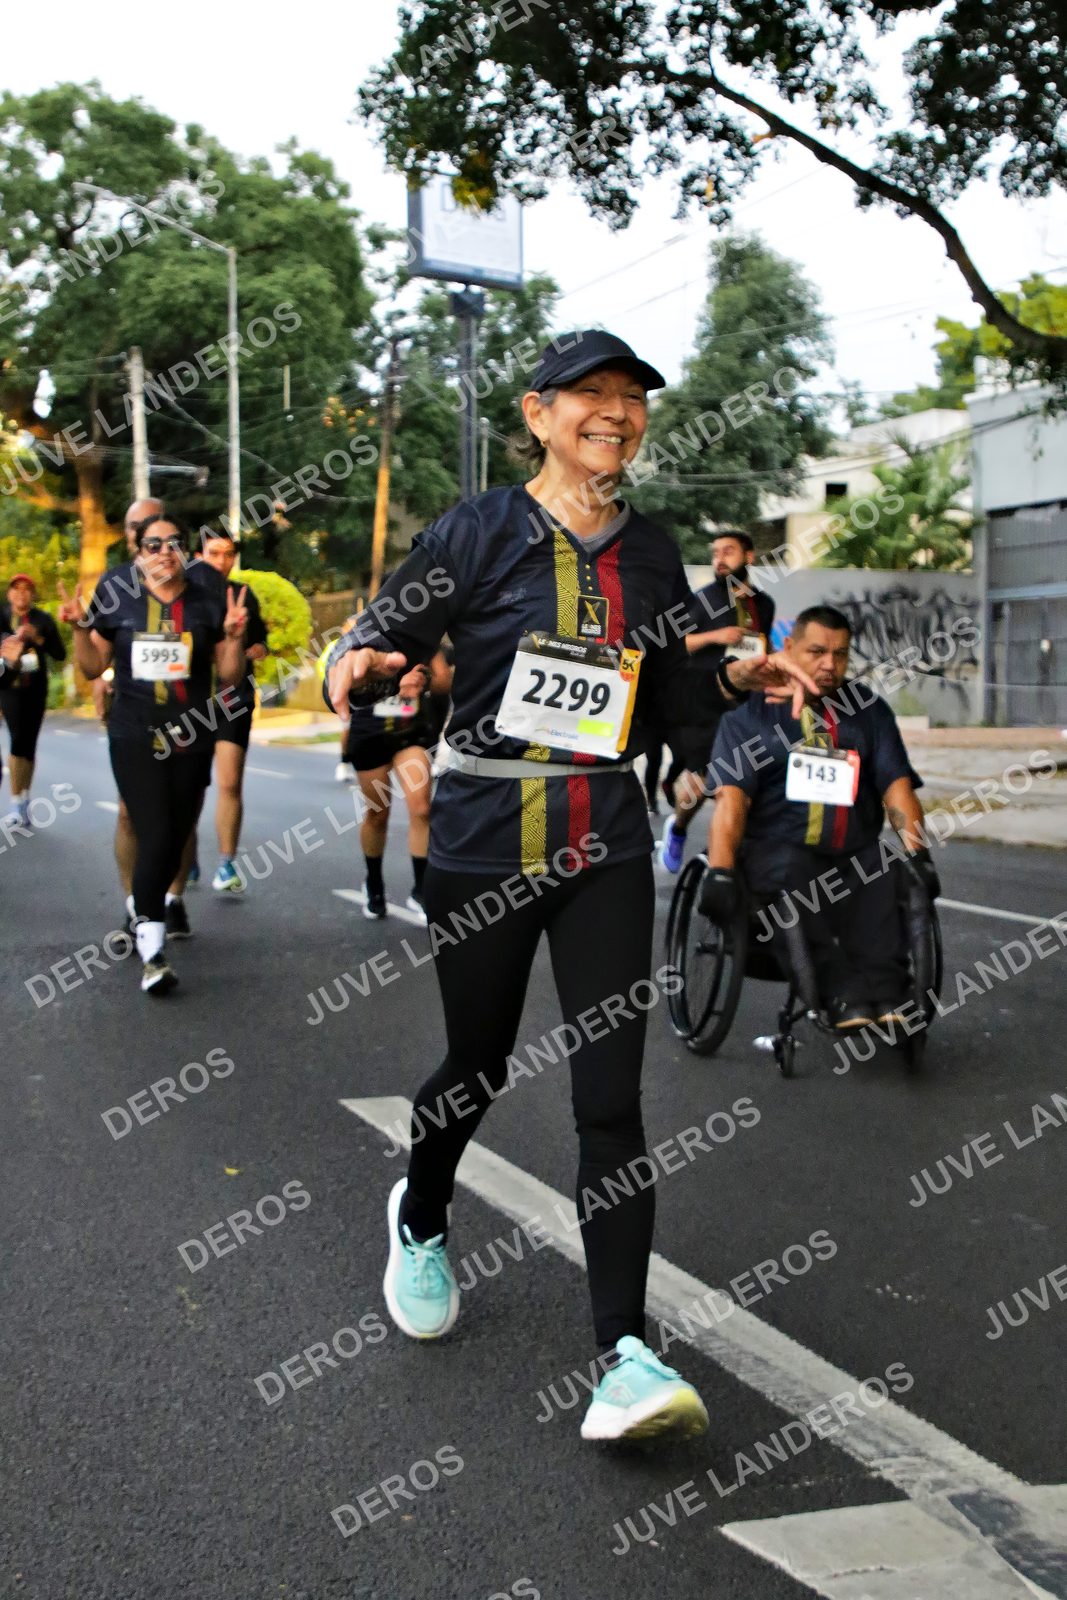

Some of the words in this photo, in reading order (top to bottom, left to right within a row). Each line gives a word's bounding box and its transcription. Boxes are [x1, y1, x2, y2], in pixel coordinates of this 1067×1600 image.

[142, 648, 179, 662] 5995
[622, 658, 635, 672] 5K
[522, 668, 611, 716] 2299
[806, 763, 836, 782] 143
